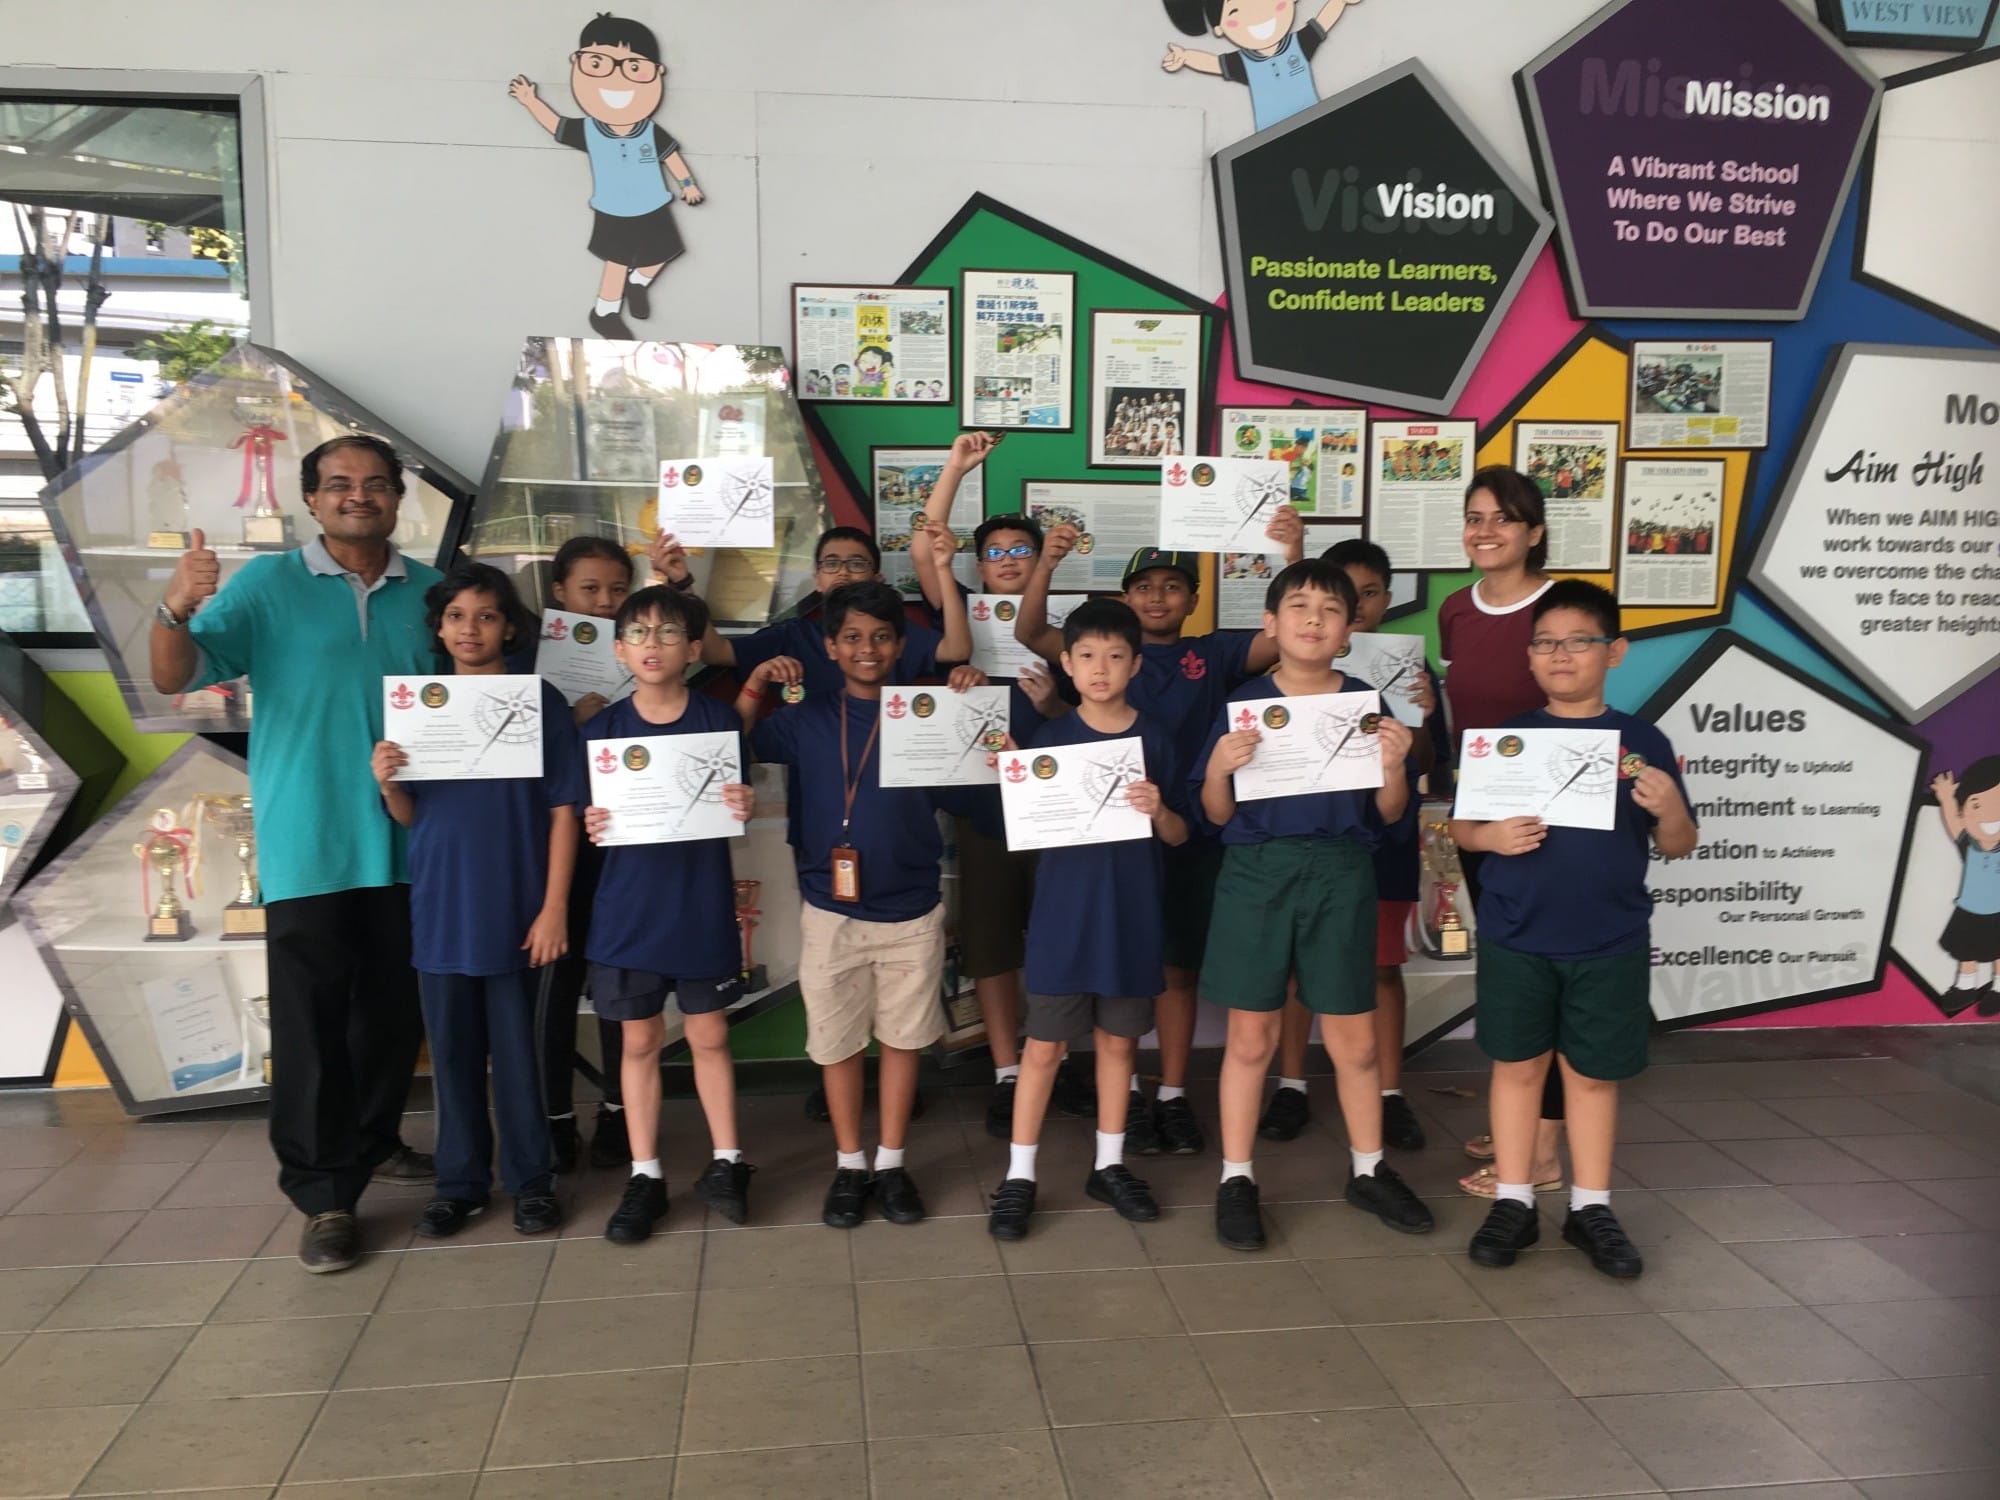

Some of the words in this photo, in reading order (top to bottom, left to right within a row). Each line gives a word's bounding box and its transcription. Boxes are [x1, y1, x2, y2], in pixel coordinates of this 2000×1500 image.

[1852, 0, 1913, 23] WEST
[1923, 4, 1979, 27] VIEW
[1683, 80, 1830, 122] Mission
[1607, 154, 1626, 177] A
[1630, 155, 1716, 181] Vibrant
[1720, 160, 1800, 185] School
[1376, 182, 1495, 220] Vision
[1606, 187, 1682, 211] Where
[1686, 190, 1723, 213] We
[1728, 192, 1797, 216] Strive
[1612, 219, 1641, 242] To
[1645, 221, 1679, 243] Do
[1684, 222, 1729, 245] Our
[1733, 224, 1787, 247] Best
[1250, 256, 1382, 280] Passionate
[1387, 258, 1498, 285] Learners,
[1267, 288, 1386, 311] Confident
[1391, 291, 1486, 313] Leaders
[1824, 449, 1899, 483] Aim
[1911, 450, 1985, 493] High
[1826, 508, 1881, 526] When
[1885, 512, 1914, 527] we
[1918, 509, 1958, 527] AIM
[1823, 535, 1872, 553] work
[1876, 536, 1955, 554] towards
[1960, 540, 1994, 554] our
[1799, 565, 1828, 579] we
[1833, 565, 1930, 580] overcome
[1934, 563, 1967, 580] the
[1855, 592, 1884, 606] we
[1888, 588, 1931, 606] face
[1935, 590, 1956, 607] to
[1860, 616, 1934, 636] greater
[1689, 702, 1808, 734] Values
[1677, 753, 1781, 780] Integrity
[1784, 762, 1800, 774] to
[1802, 761, 1853, 776] Uphold
[1694, 796, 1796, 818] mitment
[1801, 804, 1817, 816] to
[1819, 802, 1881, 818] Learning
[1762, 847, 1778, 859] to
[1780, 846, 1835, 859] Achieve
[1651, 880, 1803, 906] esponsibility
[1719, 910, 1746, 924] Our
[1749, 909, 1811, 923] Personal
[1813, 908, 1866, 921] Growth
[1650, 944, 1774, 968] Excellence
[1777, 951, 1804, 964] Our
[1806, 950, 1857, 963] Pursuit
